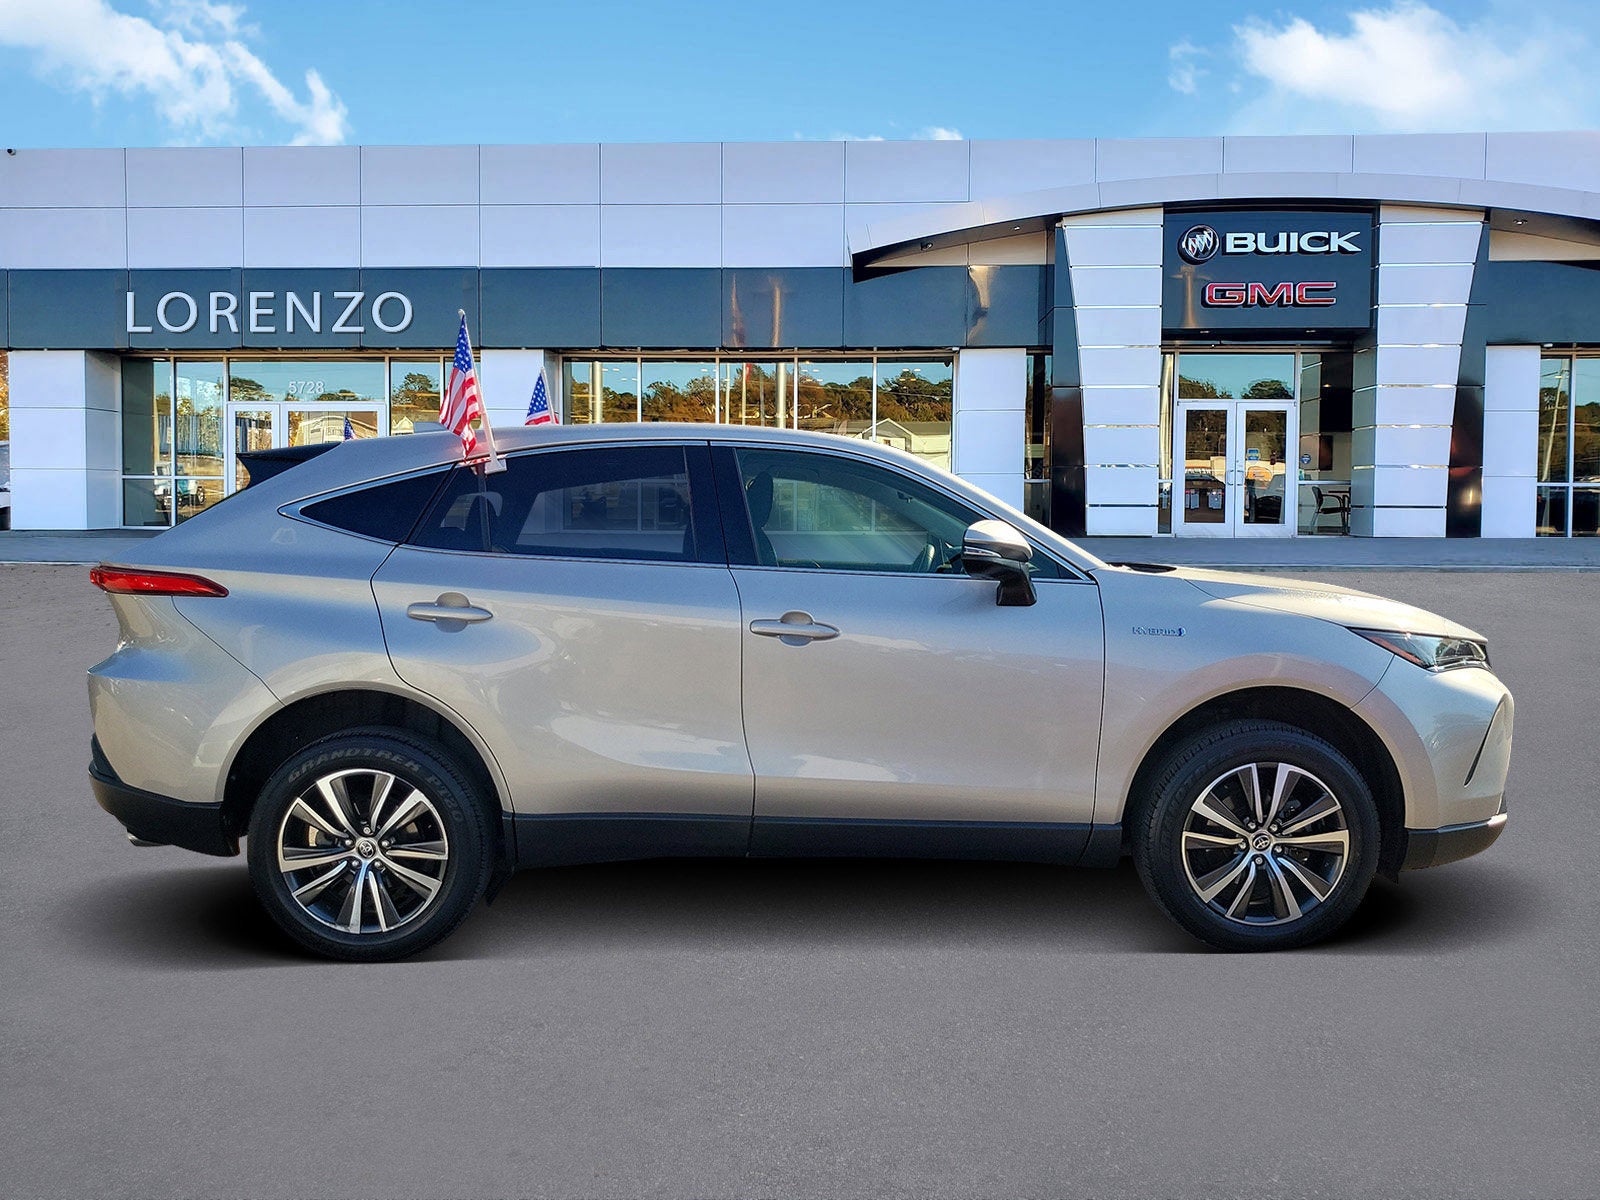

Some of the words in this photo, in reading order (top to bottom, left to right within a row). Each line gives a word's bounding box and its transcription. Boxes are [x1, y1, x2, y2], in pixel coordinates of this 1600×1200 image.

[1226, 232, 1362, 253] BUICK
[1206, 282, 1337, 306] GMC
[126, 291, 414, 333] LORENZO
[288, 381, 325, 394] 5728
[288, 747, 422, 783] GRANDTREK
